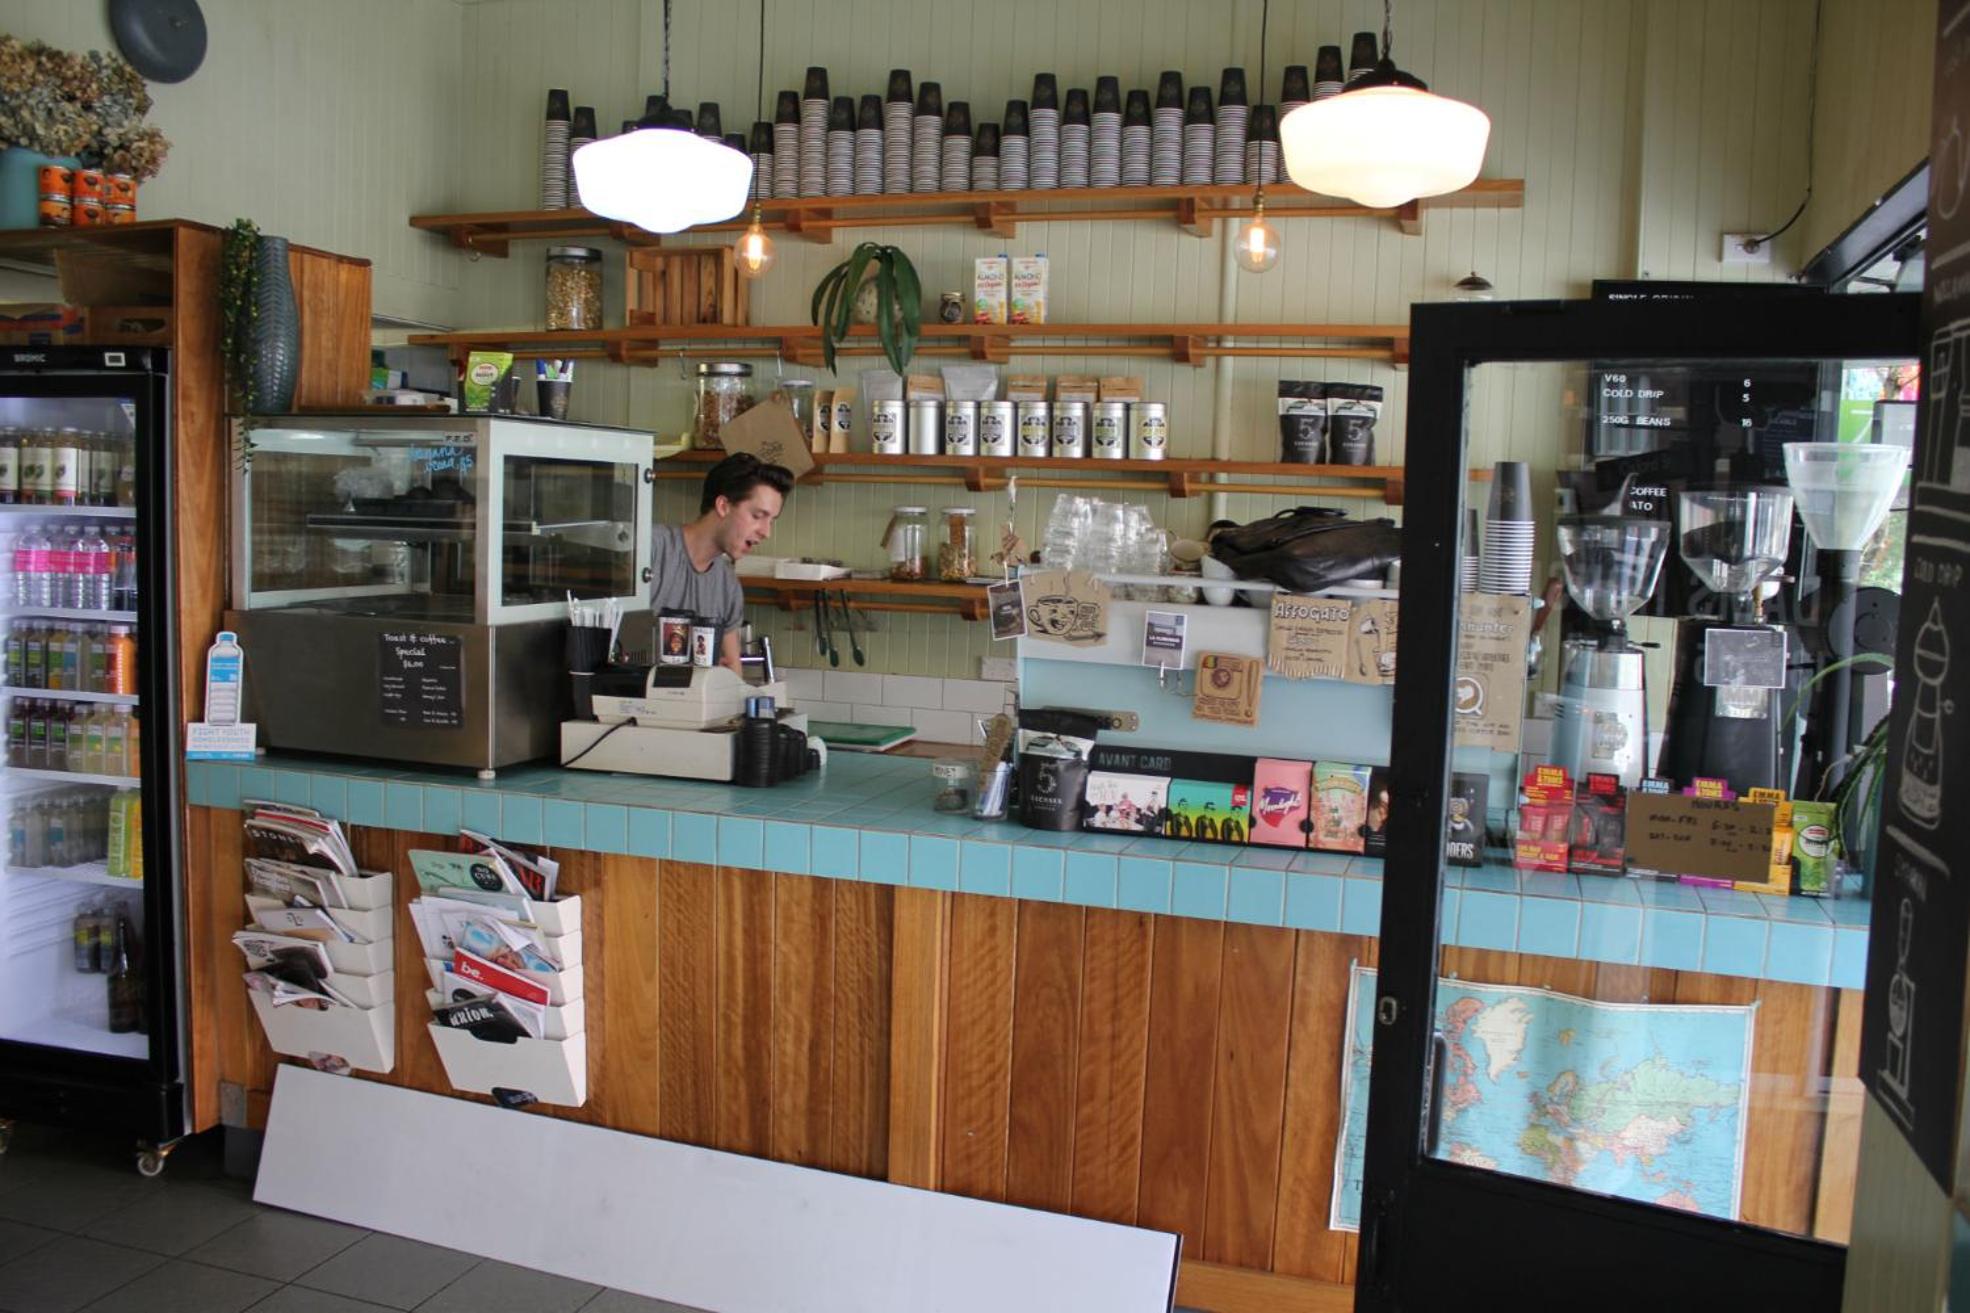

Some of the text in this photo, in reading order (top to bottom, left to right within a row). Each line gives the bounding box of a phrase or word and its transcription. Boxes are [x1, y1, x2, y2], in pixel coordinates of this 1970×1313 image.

[1604, 374, 1752, 388] V60 6
[1602, 388, 1750, 403] COLD DRIP 5
[1601, 415, 1630, 425] 250G
[1636, 416, 1671, 427] BEANS
[395, 646, 427, 660] Special
[1098, 752, 1172, 771] AVANT CARD
